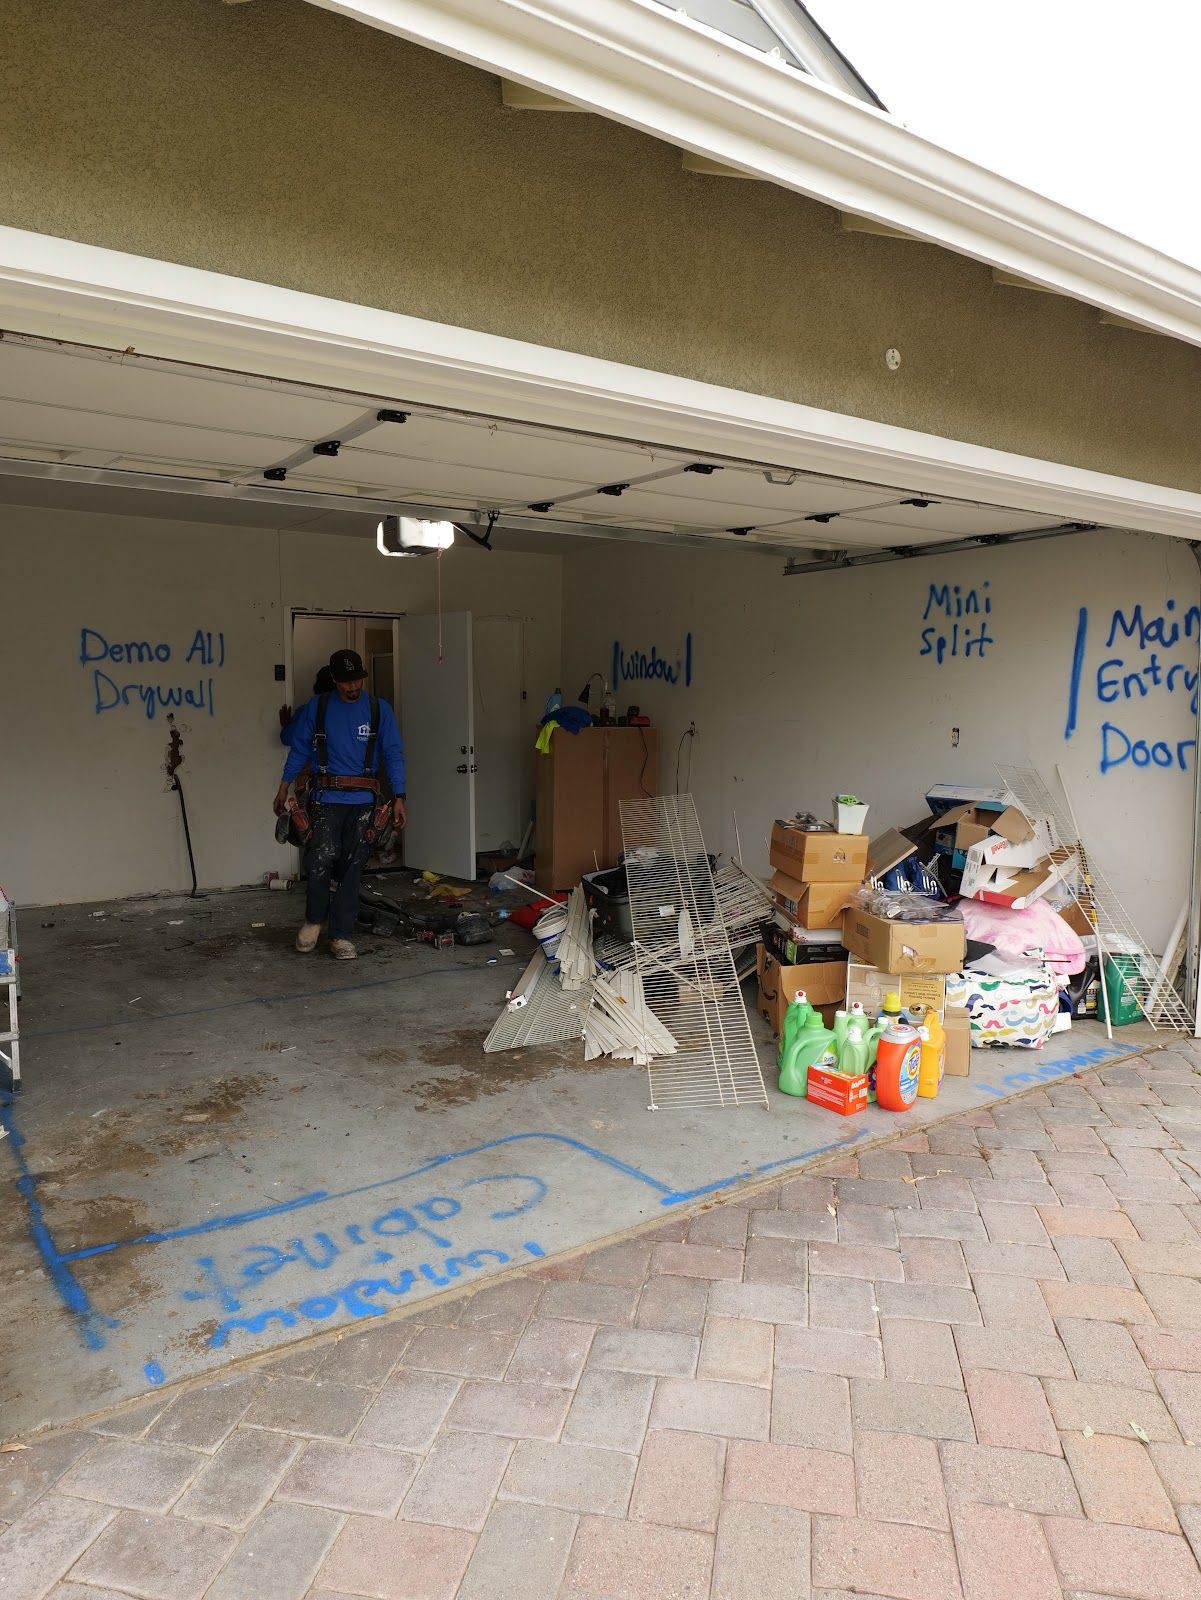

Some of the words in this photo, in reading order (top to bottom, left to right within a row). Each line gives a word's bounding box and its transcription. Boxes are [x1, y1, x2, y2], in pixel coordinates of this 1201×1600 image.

[922, 581, 991, 620] Mini
[1105, 599, 1201, 650] Main
[80, 628, 171, 667] Demo
[186, 630, 225, 667] All
[919, 622, 993, 664] Split
[93, 669, 215, 719] Drywall
[1096, 654, 1200, 715] Entry
[1100, 722, 1196, 775] Door
[908, 1051, 920, 1073] Tide
[182, 1173, 549, 1312] Cabinet
